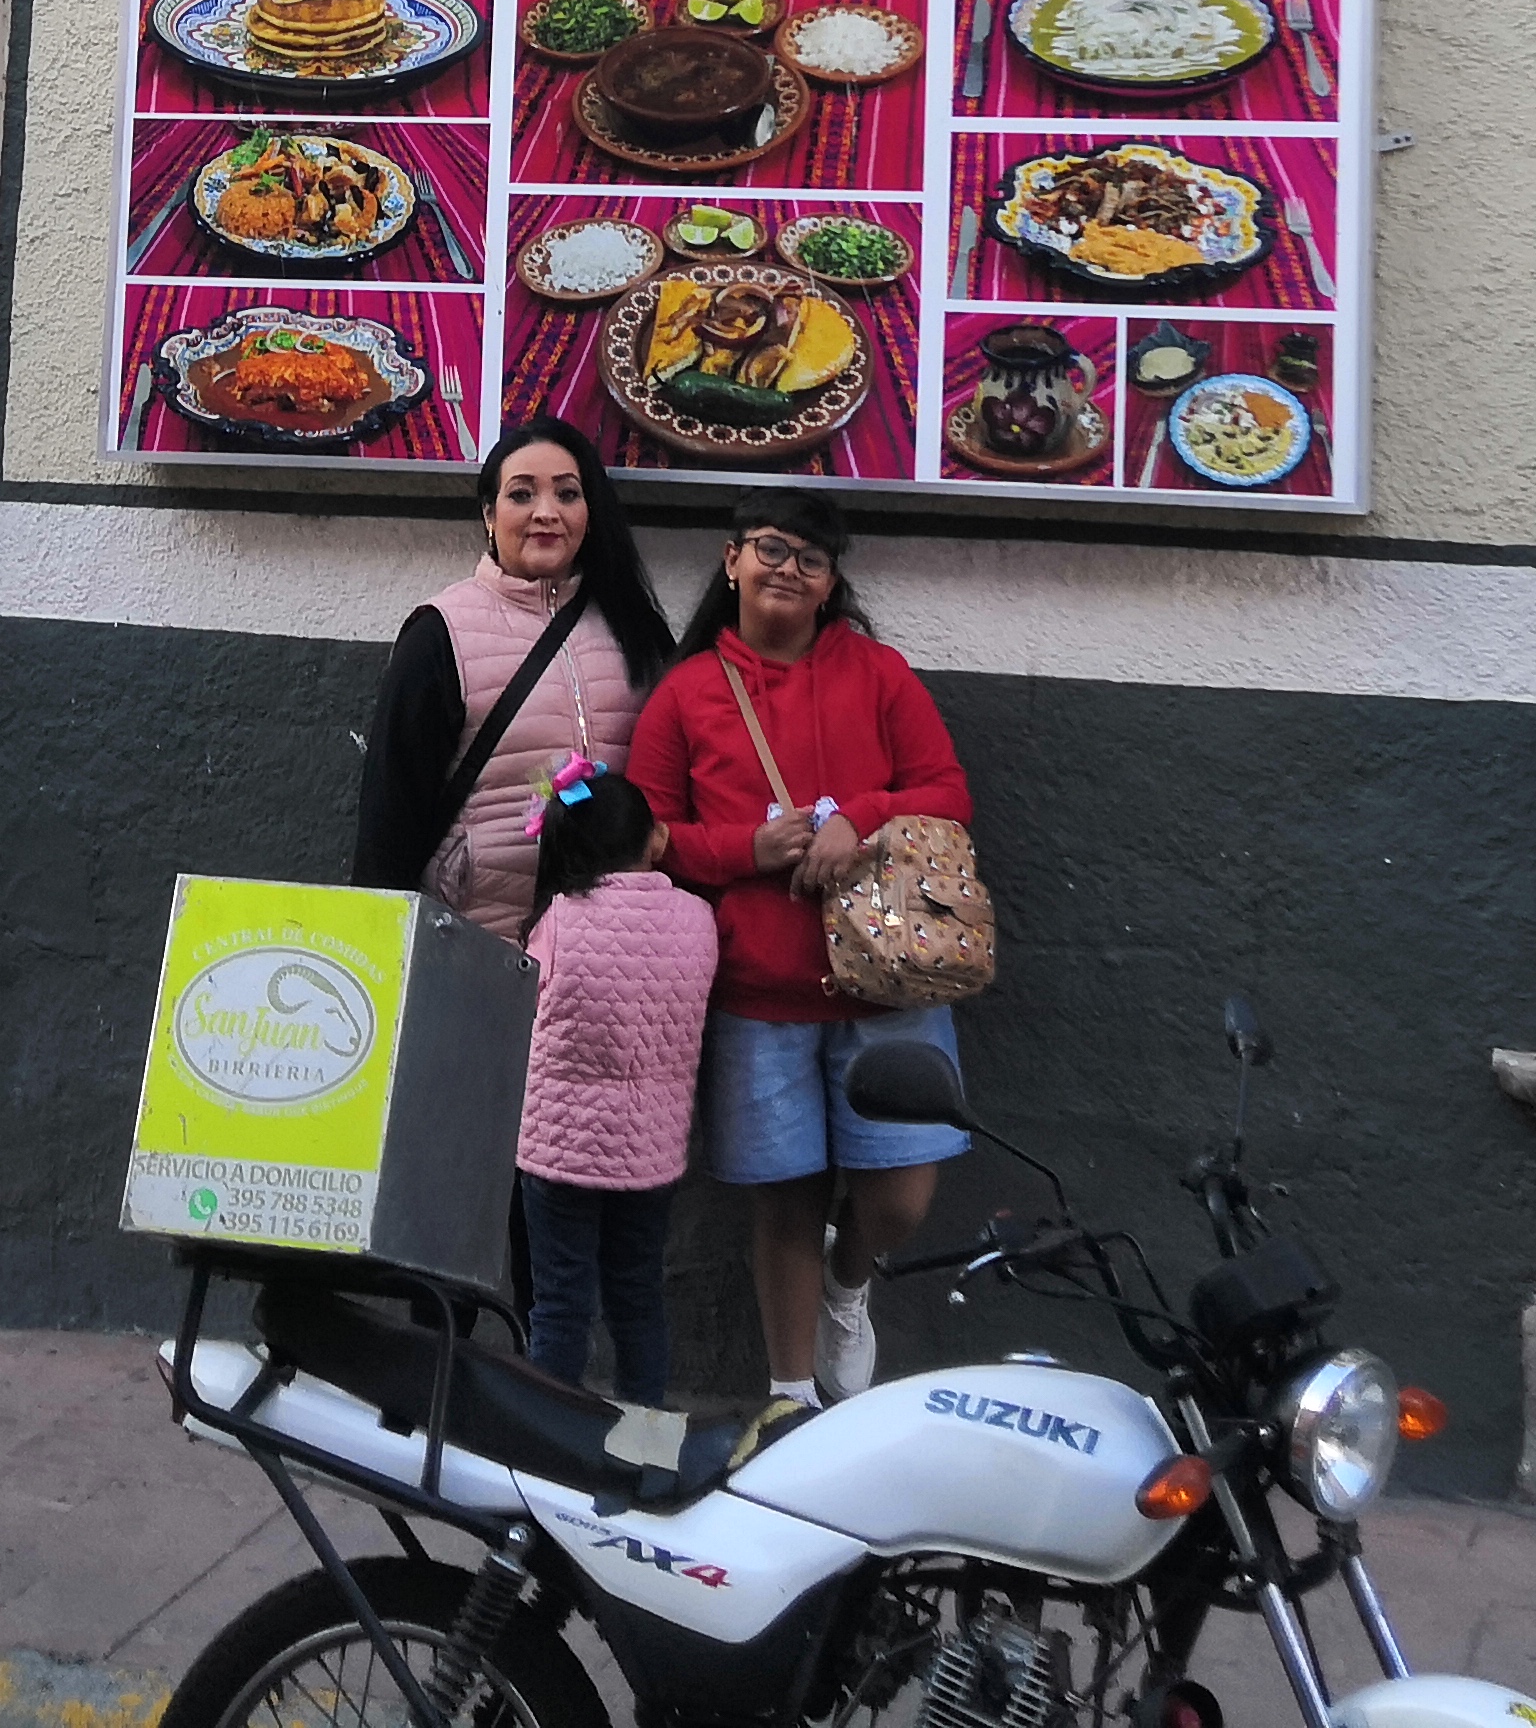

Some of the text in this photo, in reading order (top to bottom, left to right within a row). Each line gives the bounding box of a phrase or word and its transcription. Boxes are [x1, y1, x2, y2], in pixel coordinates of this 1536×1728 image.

[208, 1059, 326, 1083] BIRRIERIA
[133, 1154, 363, 1194] SERVICIO A DOMICILIO
[227, 1188, 363, 1220] 395 788 5348
[224, 1211, 361, 1243] 395 115 6169
[924, 1388, 1102, 1456] SUZUKI
